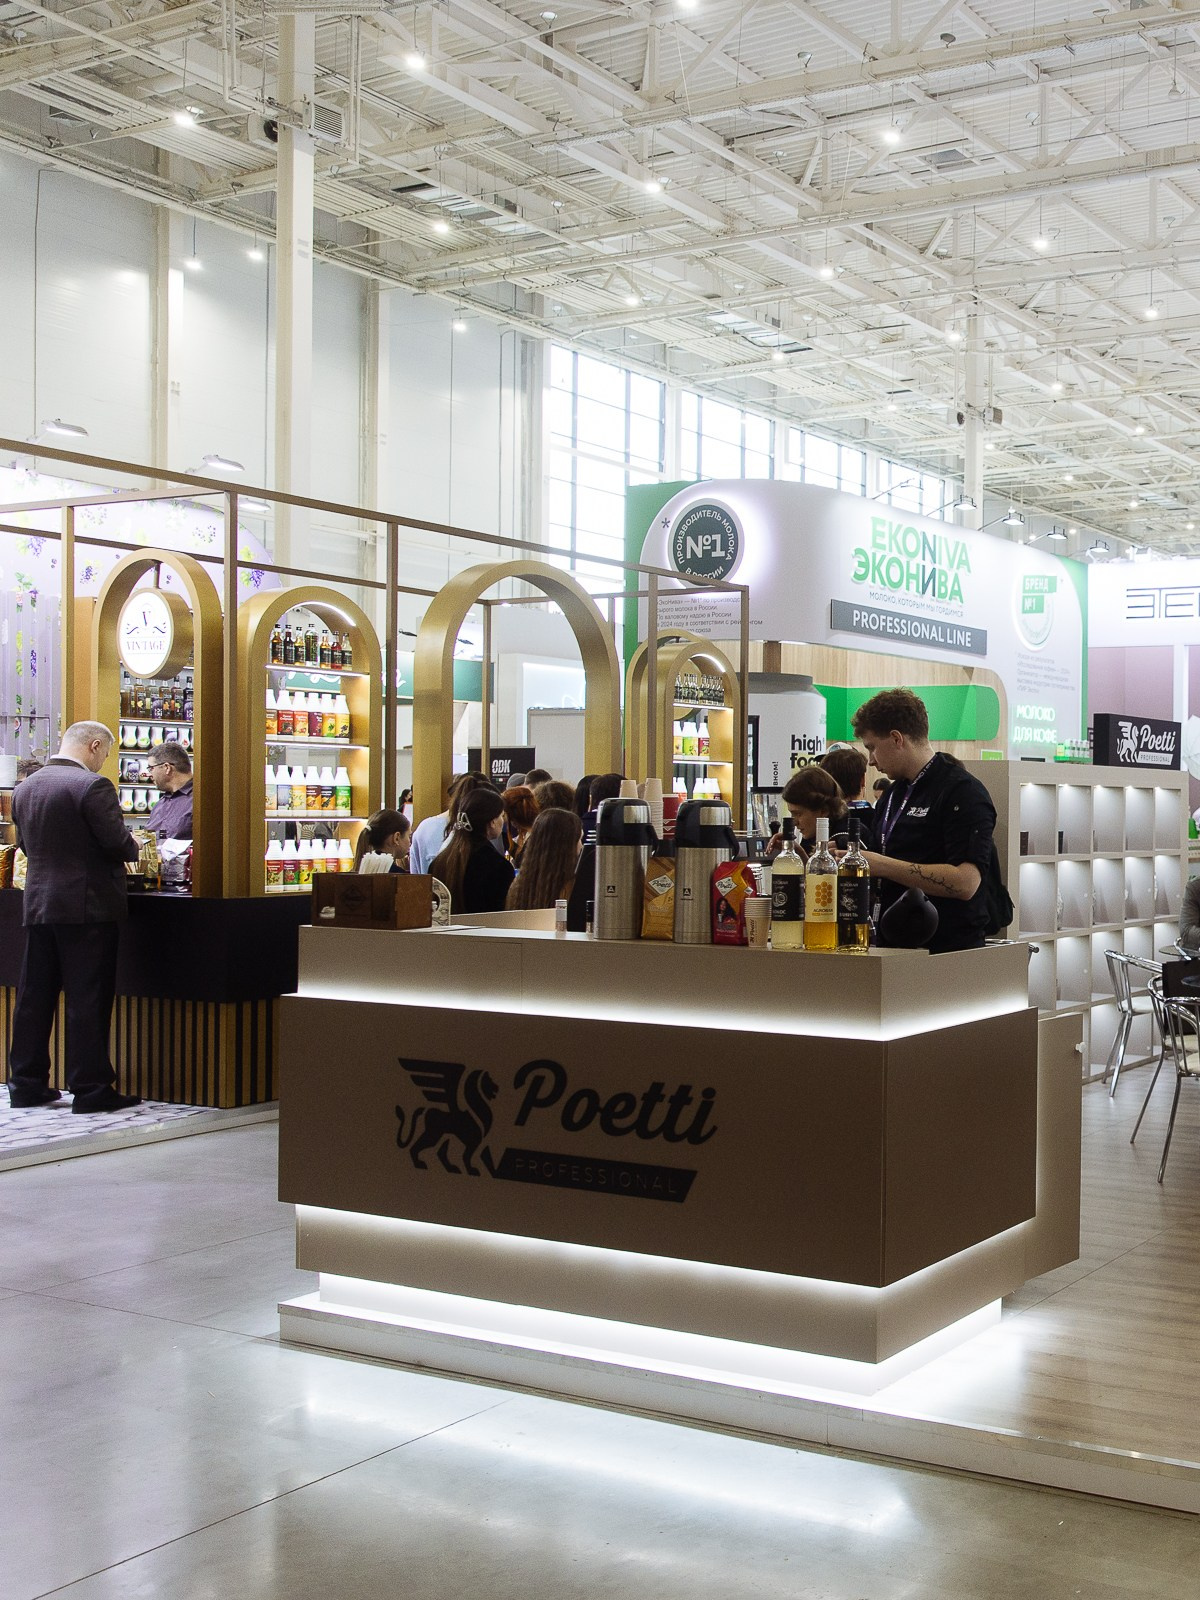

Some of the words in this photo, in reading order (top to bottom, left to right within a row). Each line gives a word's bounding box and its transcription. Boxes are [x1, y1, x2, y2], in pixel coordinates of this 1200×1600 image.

[676, 509, 722, 564] ПРОИЗВОДИТЕЛЬ
[721, 518, 736, 561] МОЛОКА
[686, 533, 726, 559] №1
[870, 516, 972, 574] EKONIVA
[852, 547, 964, 604] ЭКОНИВА
[852, 609, 945, 642] PROFESSIONAL
[946, 629, 972, 647] LINE
[1016, 704, 1056, 722] МОЛОКО
[791, 733, 822, 755] high
[1013, 726, 1032, 743] ДЛЯ
[1033, 728, 1057, 744] КОФЕ
[1139, 724, 1176, 751] Poetti
[491, 759, 512, 774] ODK
[513, 1059, 718, 1145] Poetti
[514, 1158, 678, 1194] PROFESSIONAL
